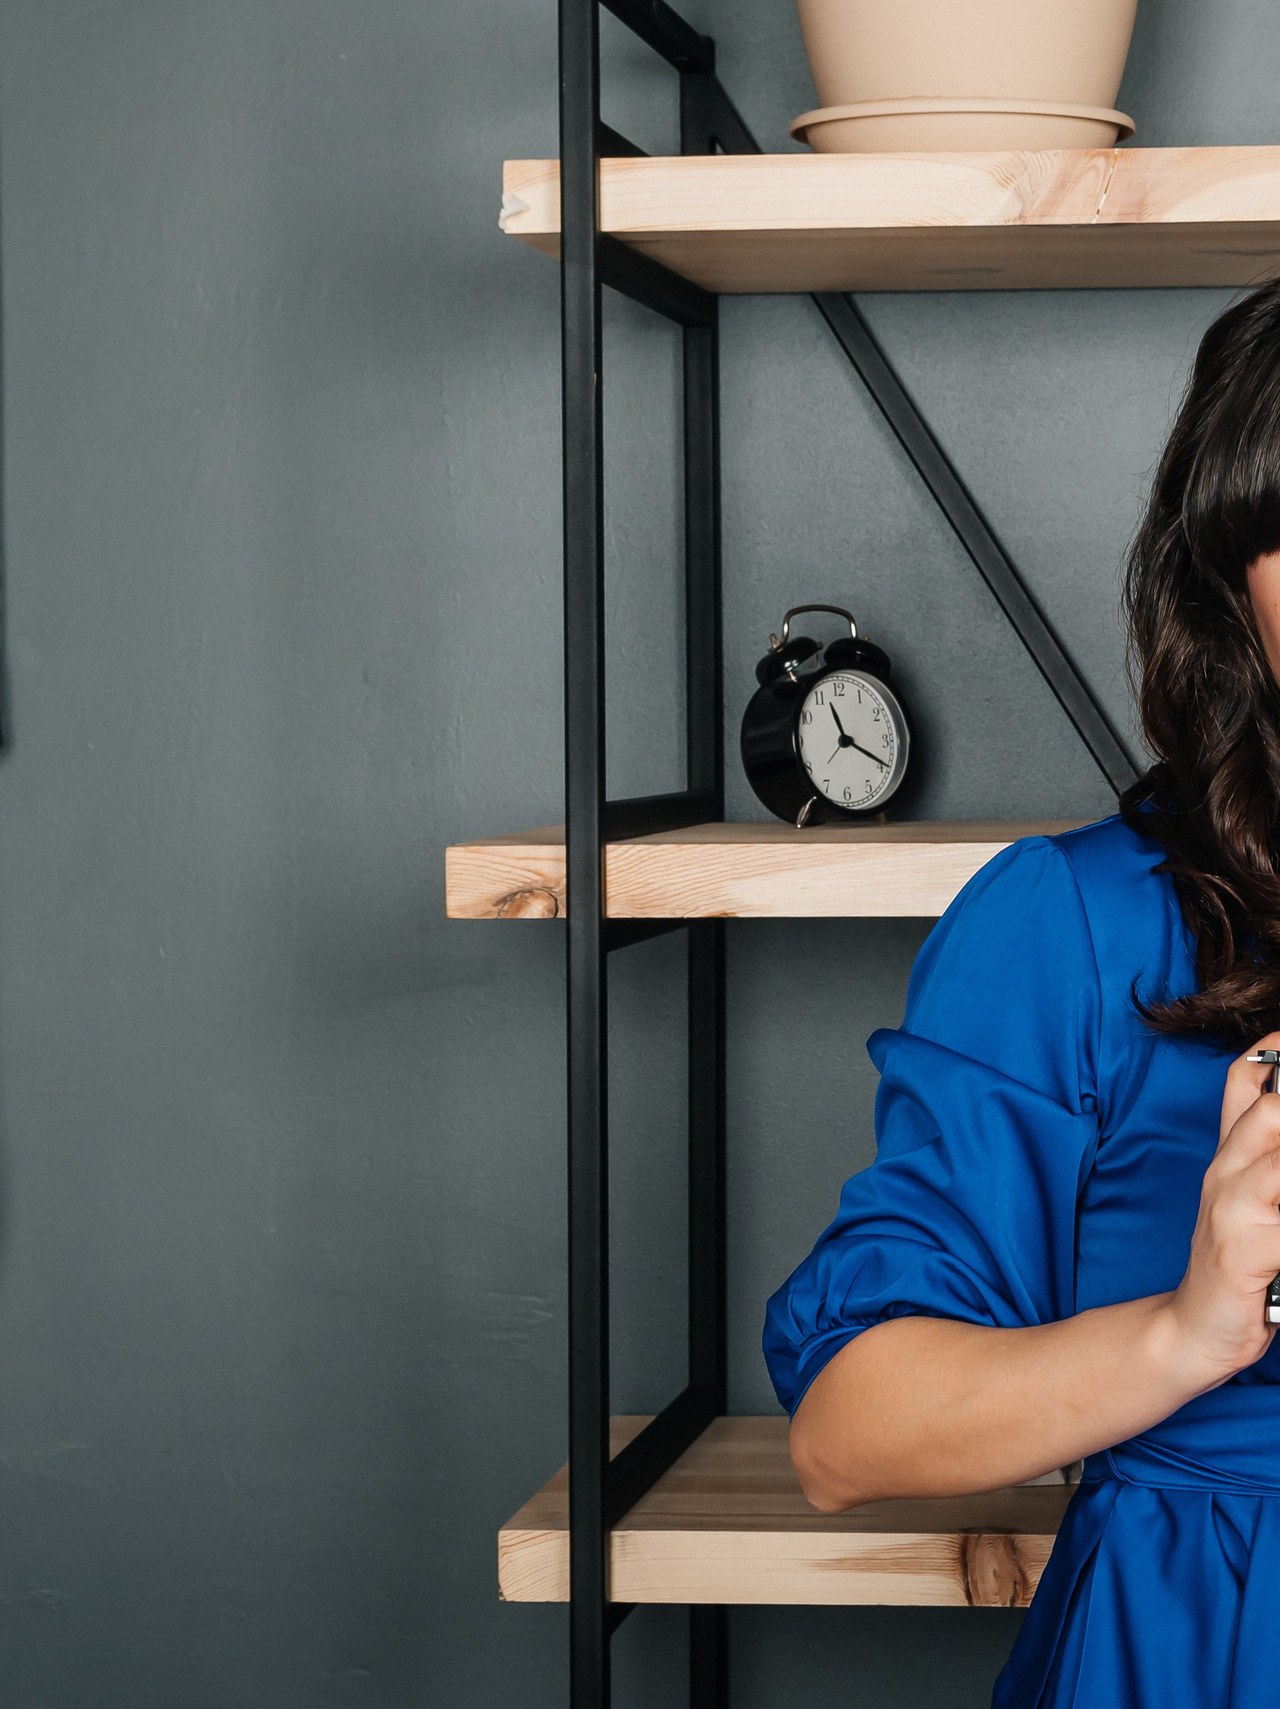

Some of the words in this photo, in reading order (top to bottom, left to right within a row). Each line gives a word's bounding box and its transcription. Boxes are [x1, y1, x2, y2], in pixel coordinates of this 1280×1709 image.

[832, 682, 845, 697] 12
[857, 689, 862, 704] 1
[814, 690, 824, 706] 11
[872, 707, 880, 722] 2
[881, 734, 890, 749] 3
[823, 779, 831, 794] 7
[843, 786, 852, 801] 6
[865, 780, 873, 794] 5
